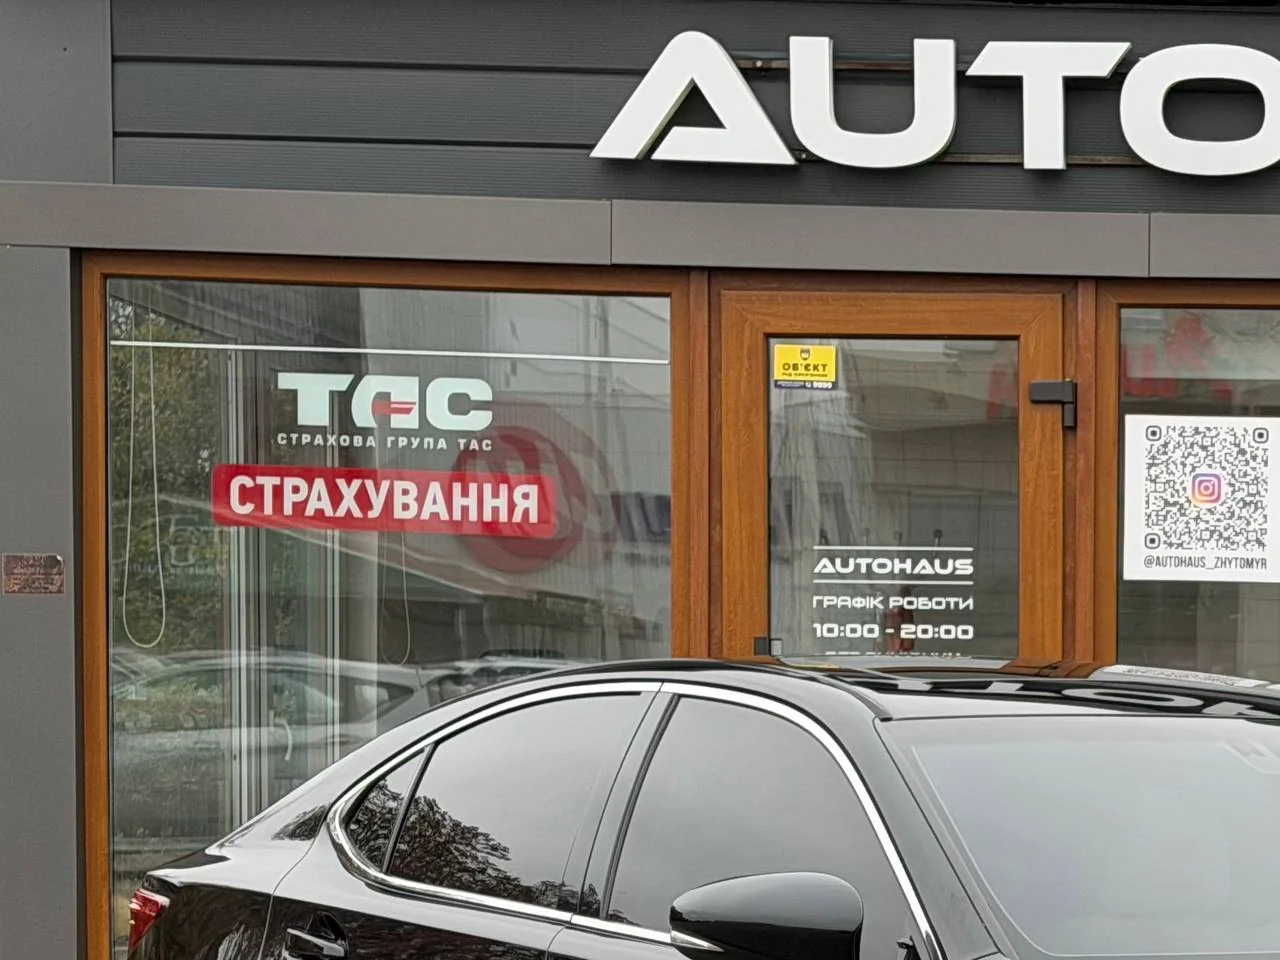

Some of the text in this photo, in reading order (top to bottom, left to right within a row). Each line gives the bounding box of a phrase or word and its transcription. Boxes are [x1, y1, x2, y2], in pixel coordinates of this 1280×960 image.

[277, 372, 493, 431] ТАС
[277, 433, 493, 451] СТРАХОВА ГРУПА ТАС
[229, 474, 539, 523] СТРАХУВАННЯ
[813, 557, 974, 575] AUTOHAUS
[1143, 555, 1267, 570] @AUTOHAUS_ZHYTOMYR
[812, 596, 974, 610] ГРАФІК РОБОТИ
[813, 623, 879, 638] 10:00
[900, 624, 974, 639] 20:00
